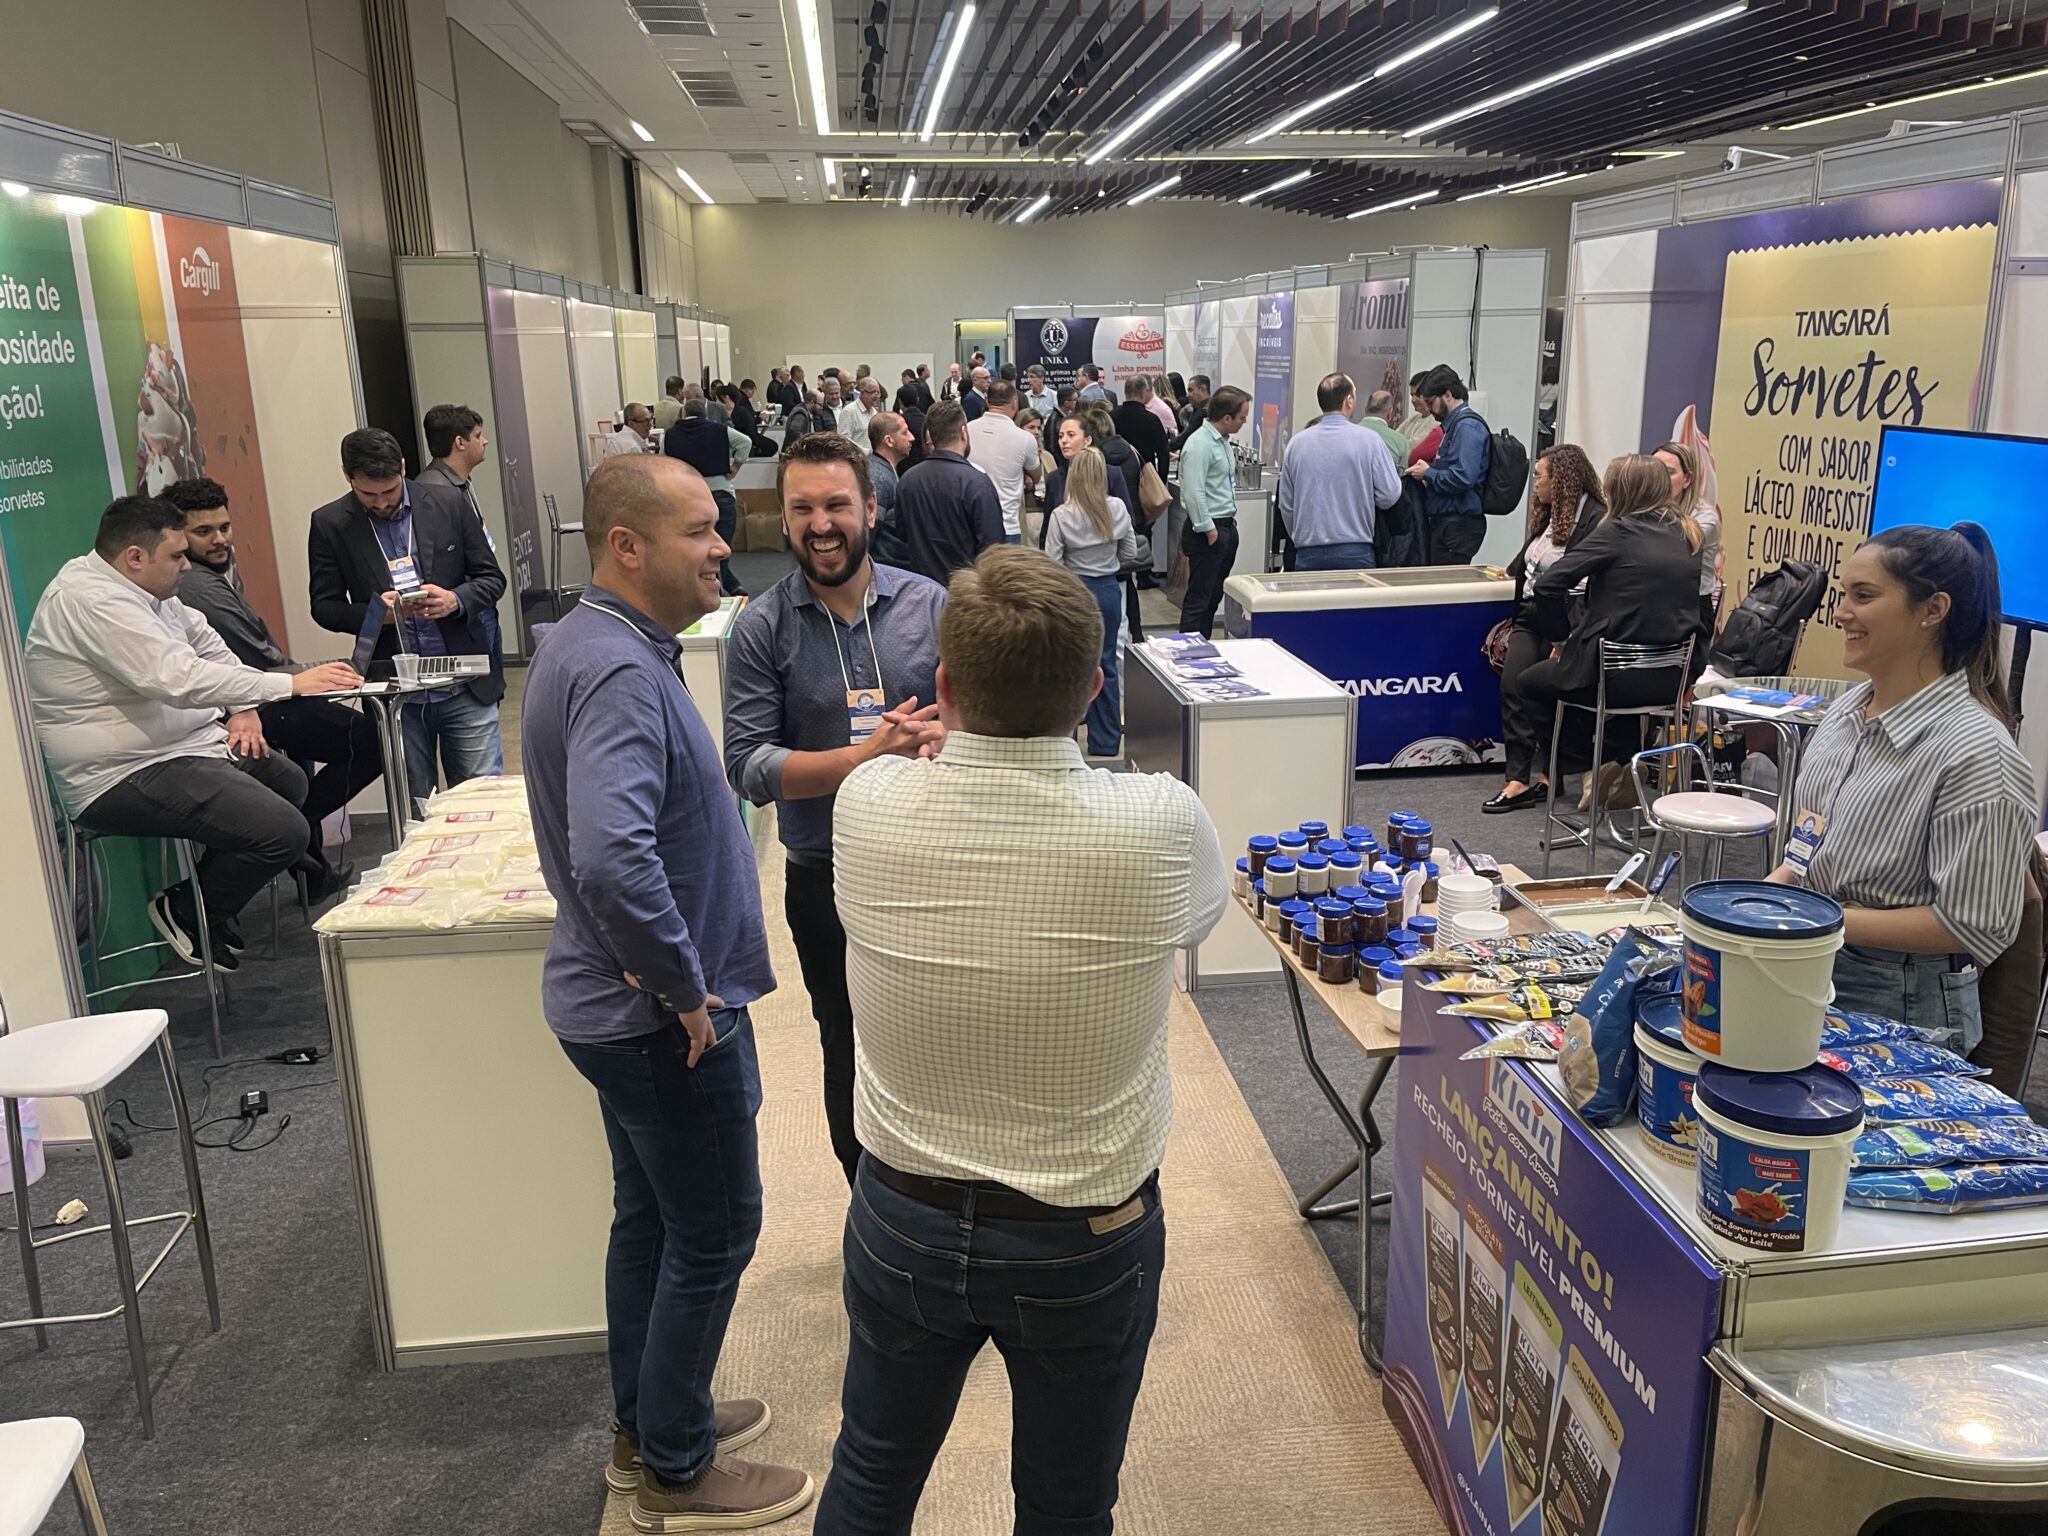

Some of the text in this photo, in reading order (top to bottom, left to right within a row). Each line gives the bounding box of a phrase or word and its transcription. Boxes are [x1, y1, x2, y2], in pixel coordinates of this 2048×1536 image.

[35, 278, 61, 311] de
[180, 257, 220, 296] Cargill
[1795, 303, 1890, 337] TANGARÁ
[0, 330, 75, 365] osidade
[1040, 356, 1069, 365] UNIKA
[1120, 341, 1164, 351] ESSENCIAL
[1112, 365, 1135, 373] Linha
[1744, 337, 1939, 425] Sorvetes
[0, 384, 45, 430] ção!
[1779, 434, 1872, 484] COM SABOR
[1744, 469, 1794, 520] LÁCTEO
[1747, 525, 1757, 559] E
[1492, 1060, 1556, 1169] Klain
[1508, 1132, 1528, 1159] com
[1441, 1073, 1614, 1312] LANÇAMENTO!
[1414, 1083, 1657, 1415] RECHEIO FORNEÁVEL PREMIUM
[1727, 1220, 1762, 1238] Sorvetes
[1770, 1231, 1800, 1240] Picolés
[1734, 1233, 1748, 1243] Ao
[1750, 1236, 1774, 1248] Leite
[1523, 1281, 1552, 1328] LEITINHO
[1520, 1333, 1546, 1382] Klain
[1571, 1361, 1618, 1442] CONDENSADO
[1570, 1418, 1599, 1474] Klain
